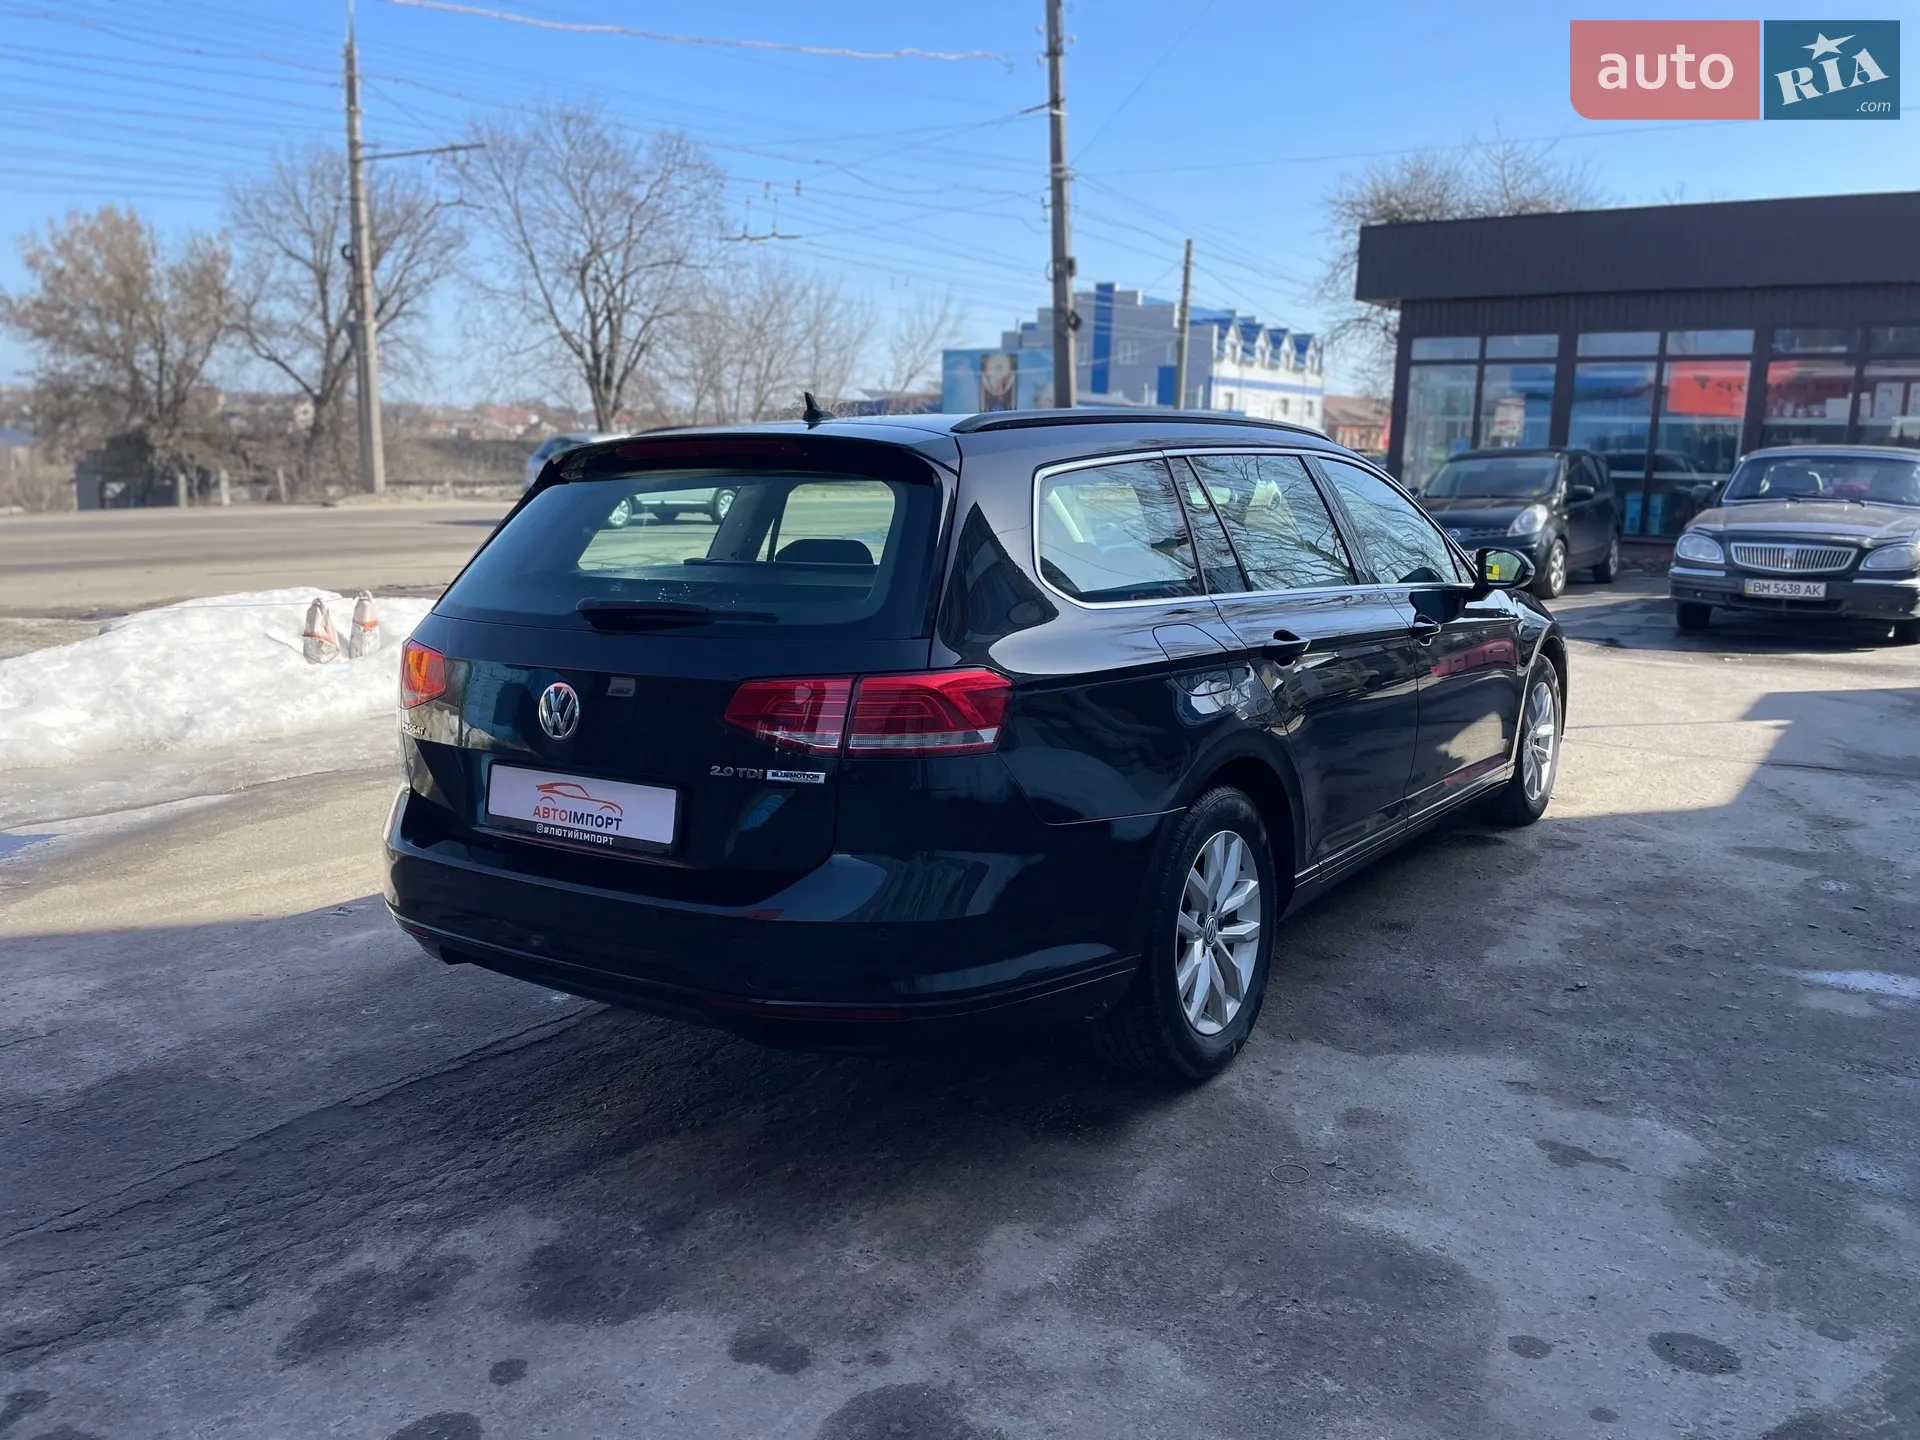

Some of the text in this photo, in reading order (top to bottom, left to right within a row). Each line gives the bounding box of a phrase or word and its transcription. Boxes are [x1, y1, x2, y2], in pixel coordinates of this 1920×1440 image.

[1753, 582, 1822, 596] BM 5438 AK
[709, 765, 734, 777] 2.0
[736, 767, 764, 779] TDI
[771, 771, 821, 781] BLUEMOTION
[532, 805, 623, 831] АВТОІМПОРТ
